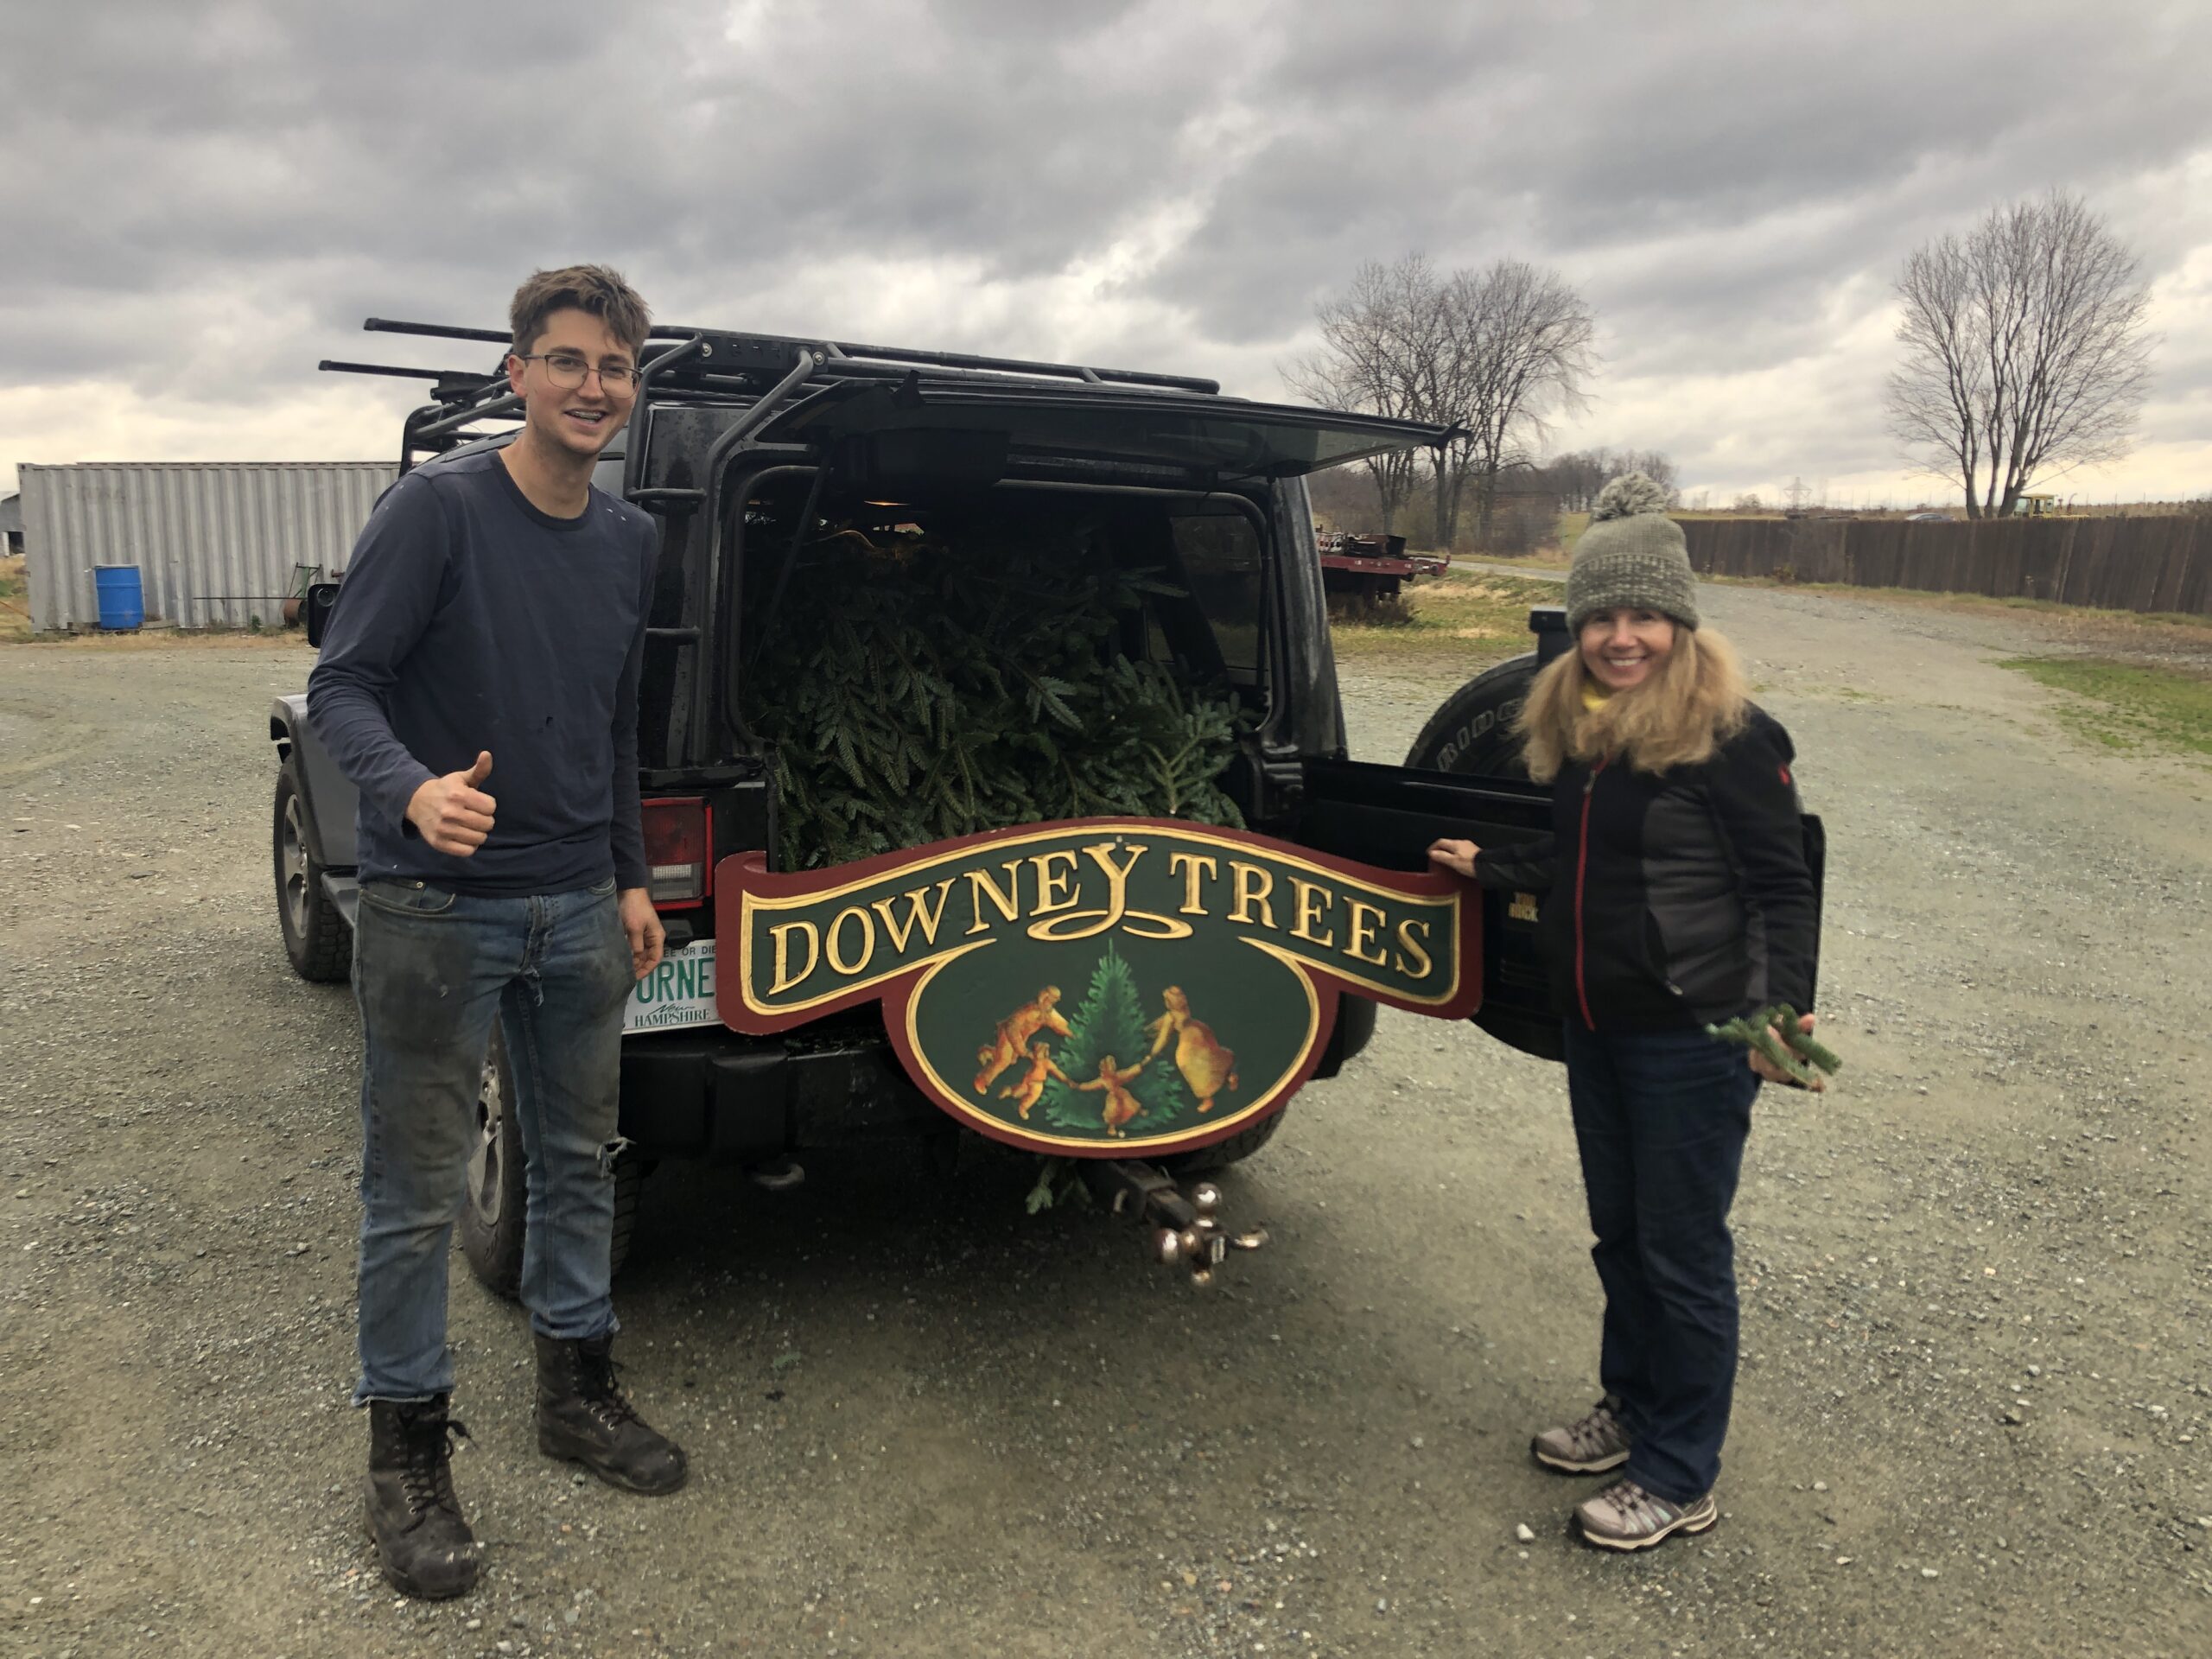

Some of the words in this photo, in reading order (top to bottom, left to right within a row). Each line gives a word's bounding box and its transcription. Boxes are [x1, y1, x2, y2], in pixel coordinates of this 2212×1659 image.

[767, 842, 1193, 997] DOWNEY
[1169, 851, 1433, 979] TREES
[682, 946, 696, 956] OR
[635, 1009, 711, 1027] HAMPSHIRE
